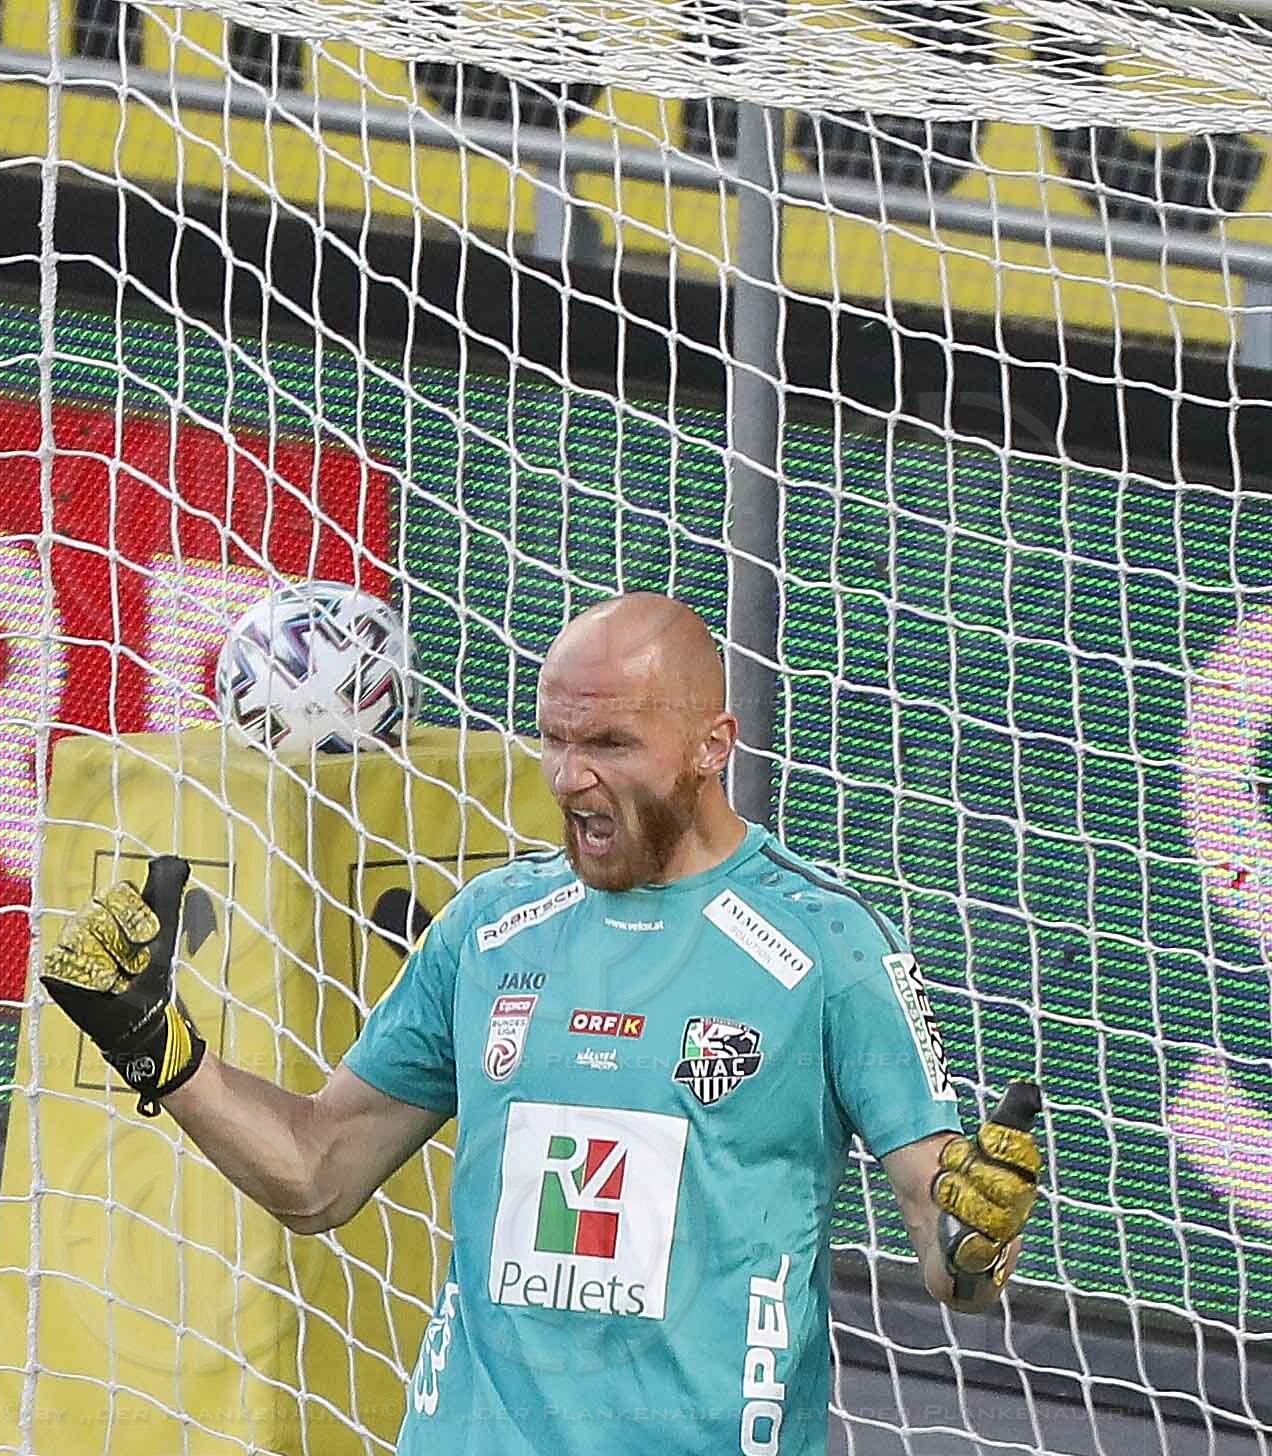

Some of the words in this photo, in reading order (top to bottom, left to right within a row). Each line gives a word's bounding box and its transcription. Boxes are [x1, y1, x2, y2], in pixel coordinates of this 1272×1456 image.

[483, 886, 580, 942] ROBITSCH
[720, 897, 805, 973] IMMOPRO
[497, 972, 547, 991] JAKO
[572, 1014, 618, 1032] ORF
[623, 1018, 642, 1035] K
[689, 1057, 746, 1078] WAC
[498, 1260, 646, 1317] Pellets
